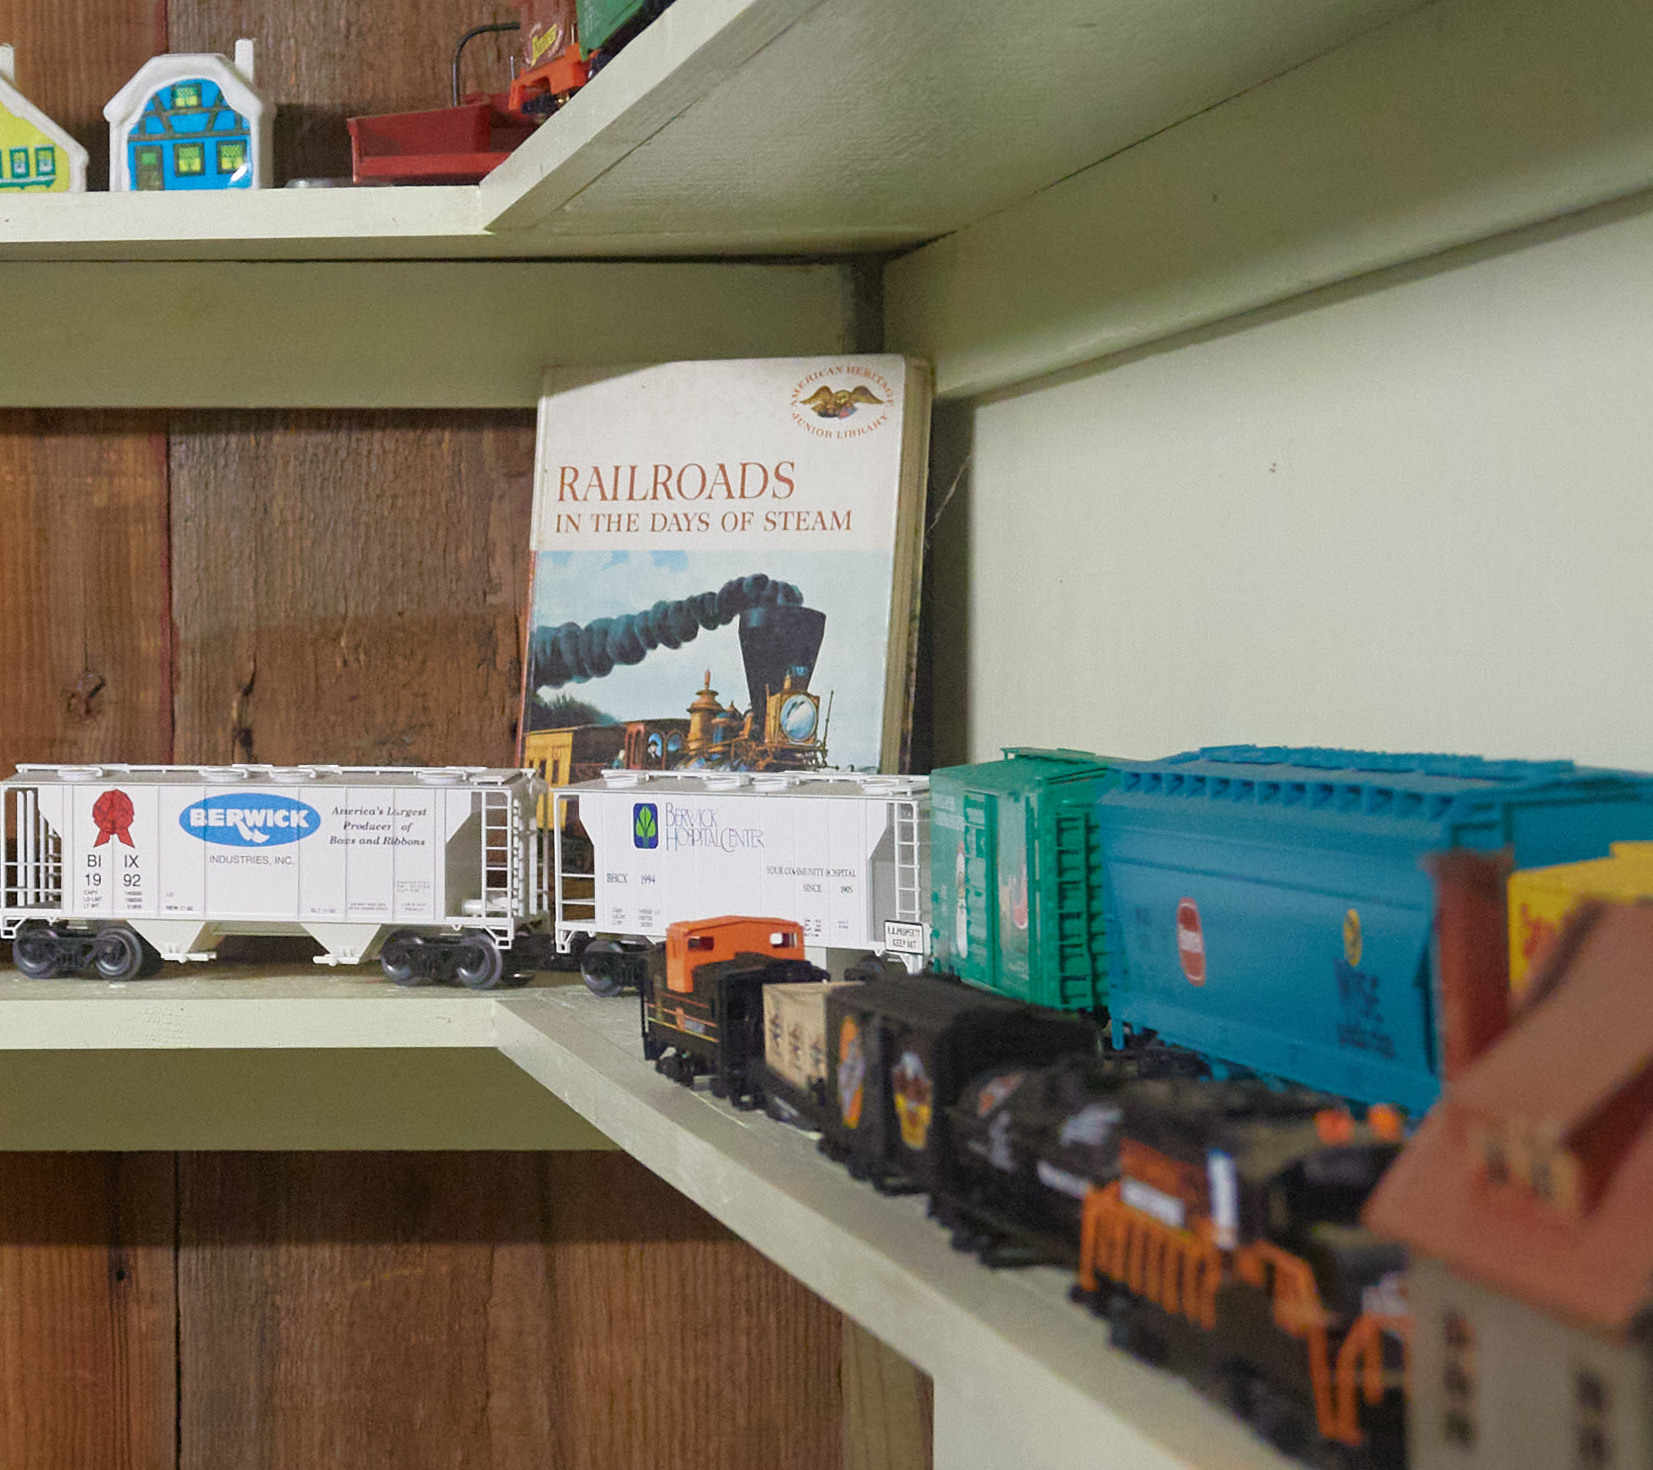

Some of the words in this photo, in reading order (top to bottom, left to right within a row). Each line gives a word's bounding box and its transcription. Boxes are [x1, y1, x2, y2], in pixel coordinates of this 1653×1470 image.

[791, 364, 844, 407] AMERICAN
[846, 364, 895, 407] HERITAGE
[791, 411, 834, 440] JUNIOR
[835, 412, 890, 440] LIBRARY
[557, 461, 796, 502] RAILROADS
[555, 512, 582, 533] IN
[591, 512, 640, 532] THE
[650, 512, 710, 532] DAYS
[721, 511, 754, 532] OF
[764, 510, 852, 531] STEAM
[331, 806, 384, 817] America's
[386, 806, 428, 818] Largest
[665, 802, 719, 828] BERWICK
[189, 808, 310, 840] BERWICK
[343, 821, 392, 831] Producer
[400, 822, 413, 833] of
[329, 835, 356, 845] Bows
[358, 836, 380, 846] and
[382, 836, 426, 847] Ribbons
[665, 827, 720, 851] HOSPITAL
[720, 828, 766, 853] CENTER
[87, 854, 102, 868] BI
[124, 854, 140, 868] IX
[209, 855, 271, 866] INDUSTRIES,
[274, 855, 295, 865] INC.
[85, 873, 102, 887] 19
[123, 873, 142, 887] 92
[606, 872, 629, 885] BHCX
